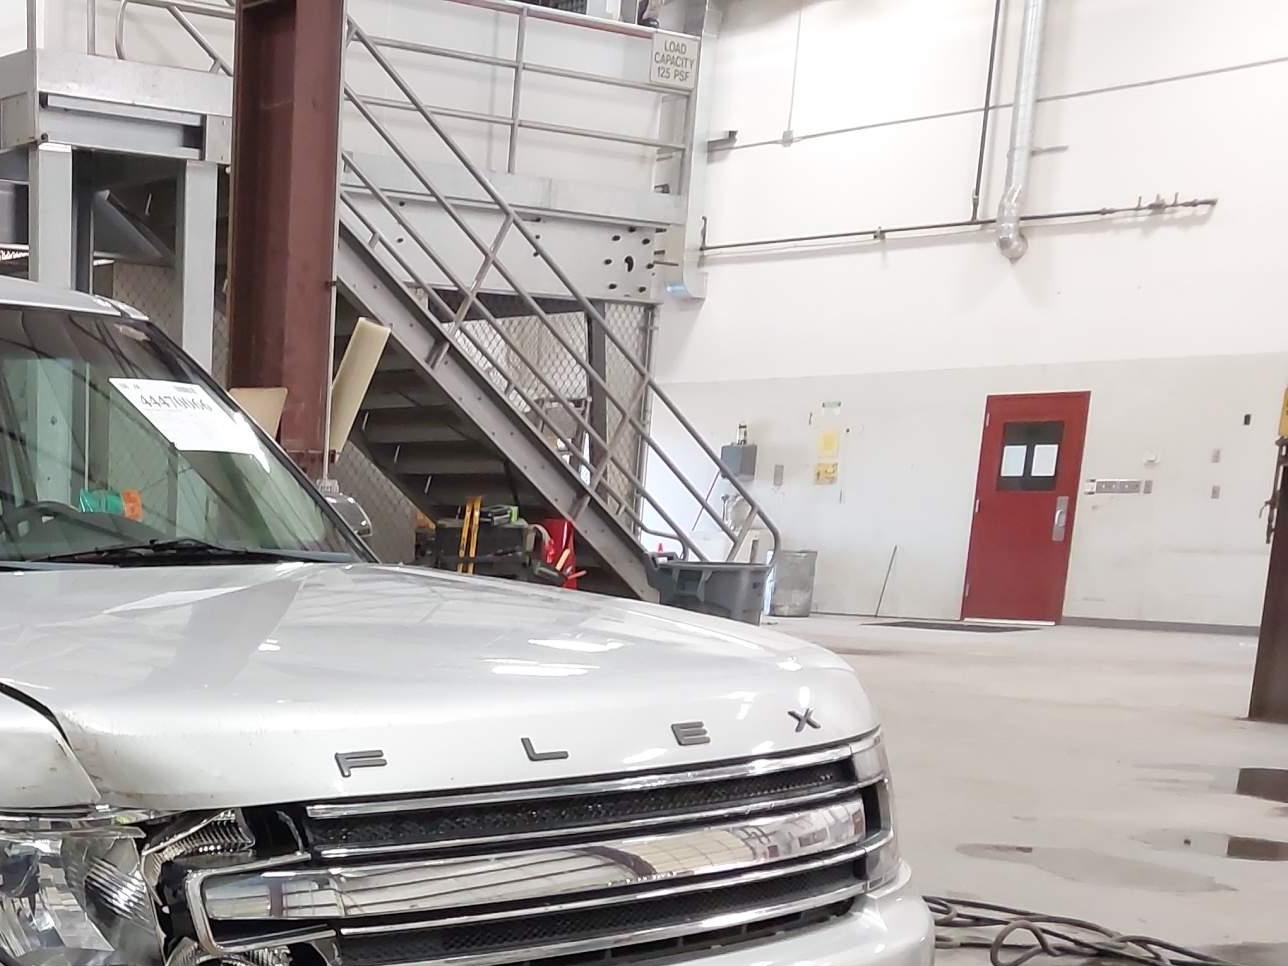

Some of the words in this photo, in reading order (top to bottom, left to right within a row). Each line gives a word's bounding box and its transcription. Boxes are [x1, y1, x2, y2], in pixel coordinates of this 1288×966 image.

[664, 39, 687, 54] LOAD
[654, 51, 695, 70] CAPACITY
[657, 66, 671, 80] 125
[673, 69, 690, 82] PSF
